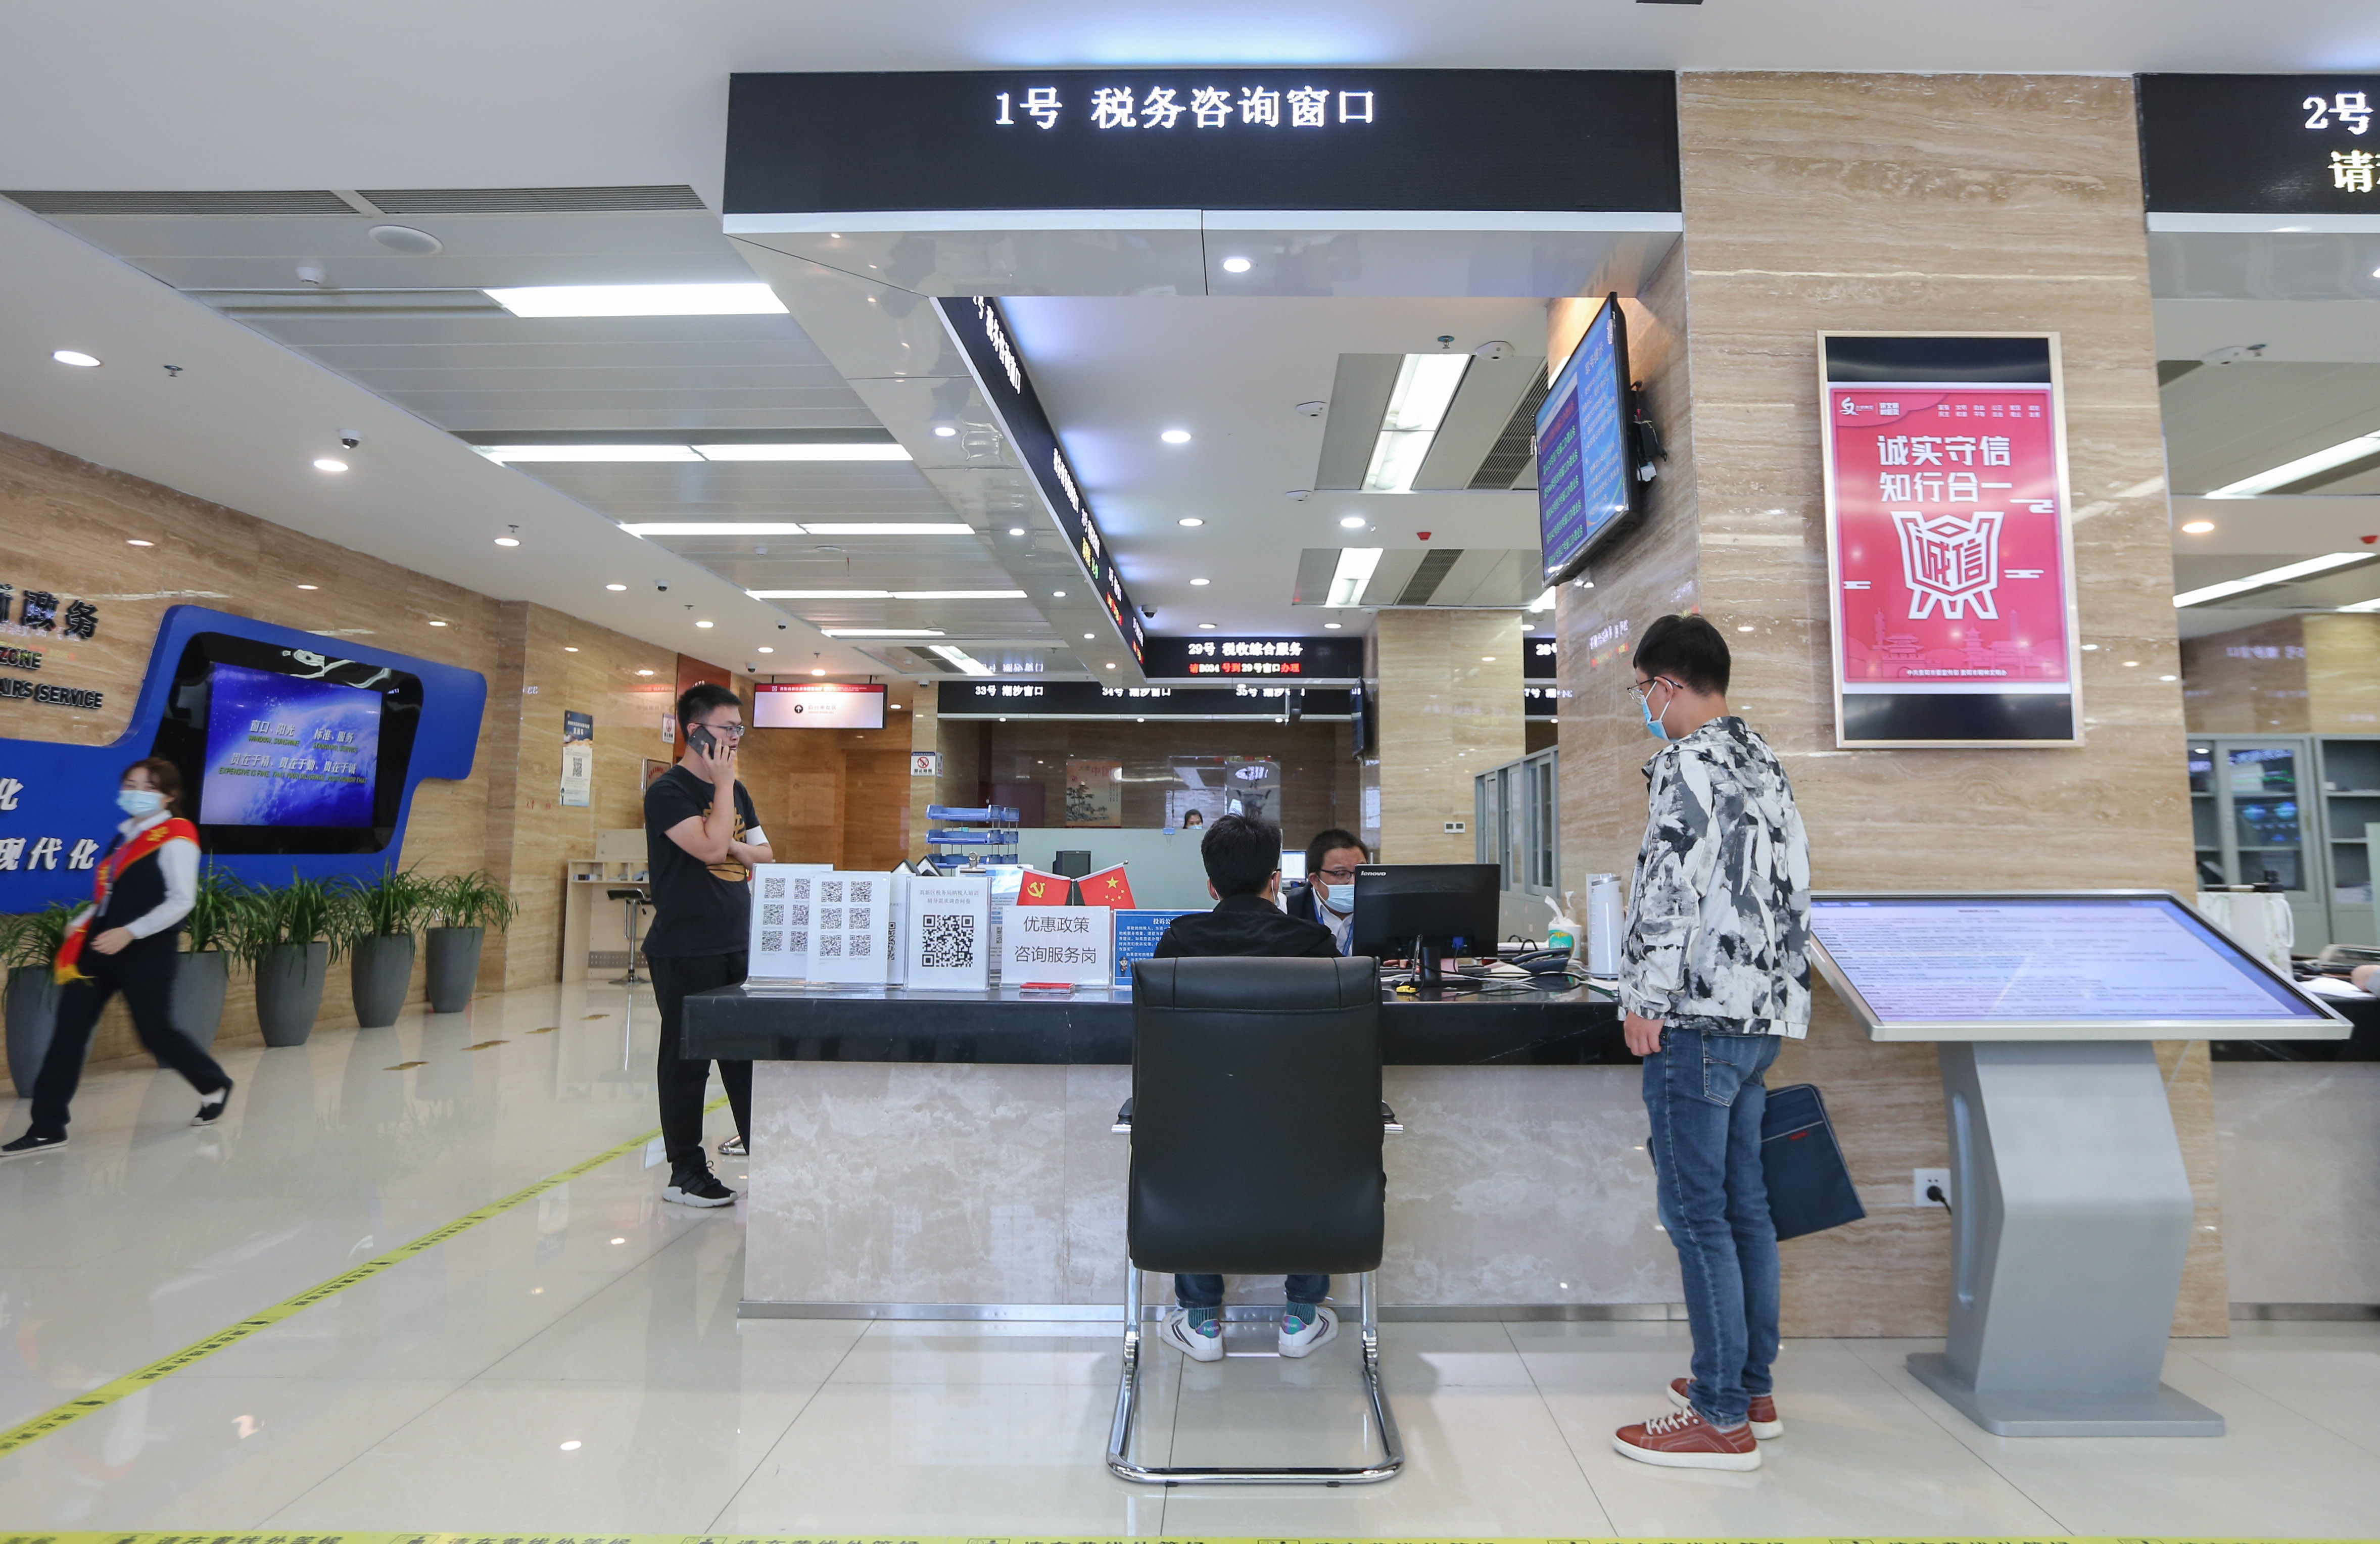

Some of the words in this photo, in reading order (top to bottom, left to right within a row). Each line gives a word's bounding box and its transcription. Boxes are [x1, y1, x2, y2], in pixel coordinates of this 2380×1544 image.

[995, 87, 1063, 129] 1号
[1090, 86, 1376, 129] 税务咨询窗口
[2302, 90, 2374, 135] 2号
[2327, 150, 2380, 193] 请
[1877, 435, 2011, 466] 诚实守信
[1879, 471, 2013, 502] 知行合一
[1188, 642, 1216, 656] 29号
[1222, 642, 1304, 656] 税收综合服务
[34, 683, 104, 709] SERVICE
[975, 685, 996, 697] 33号
[0, 837, 100, 870] 现代化
[1023, 915, 1090, 934] 优惠政策
[1015, 945, 1097, 964] 咨询服务岗
